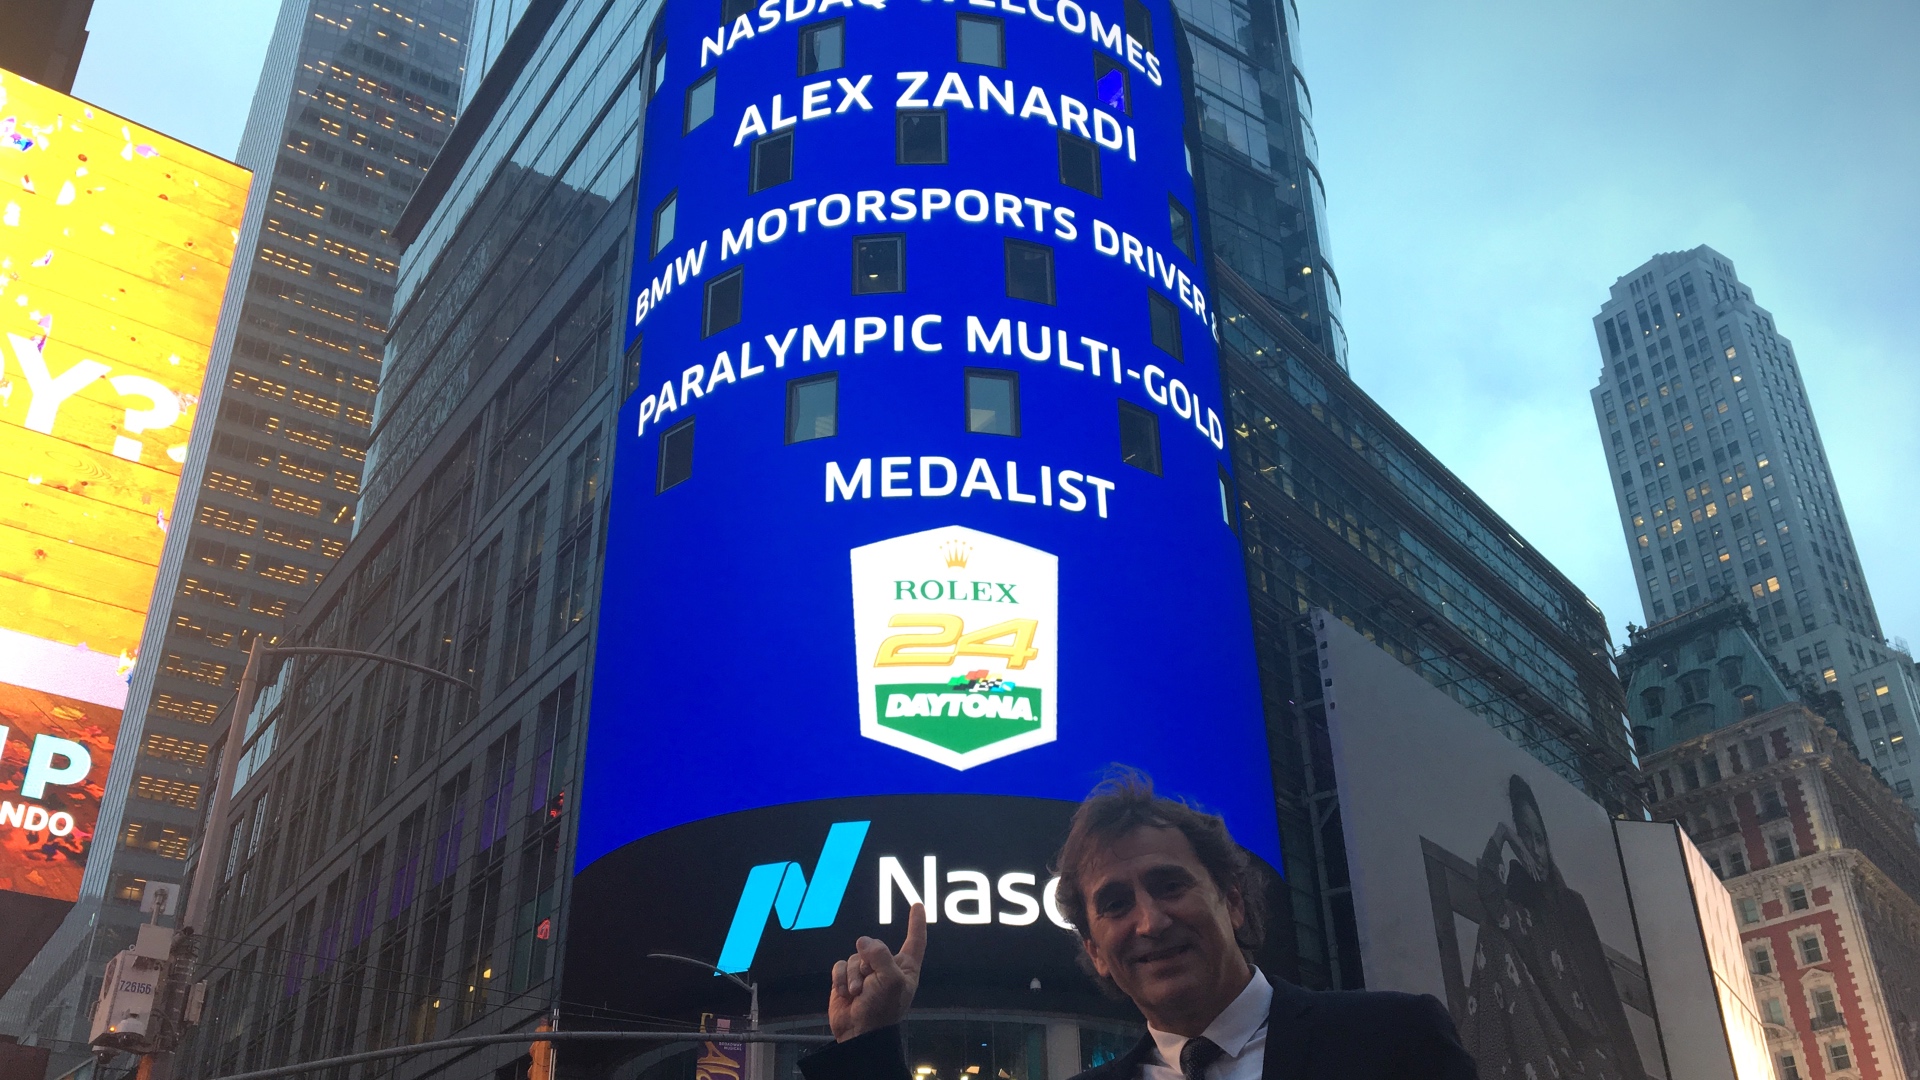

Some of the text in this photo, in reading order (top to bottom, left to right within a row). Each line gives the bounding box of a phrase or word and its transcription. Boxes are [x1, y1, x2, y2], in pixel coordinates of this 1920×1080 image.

[699, 0, 1163, 87] NASD COMES
[733, 72, 1137, 163] ALEX ZANARDI
[635, 240, 708, 327] BMW
[720, 187, 1078, 262] MOTORSPORTS
[1093, 219, 1208, 326] DRIVER
[0, 332, 181, 463] Y?
[637, 314, 1225, 451] PARALYMPIC MULTI-GOLD
[825, 456, 1116, 520] MEDALIST
[893, 579, 1020, 604] ROLEX
[873, 613, 1039, 670] 24
[884, 693, 1034, 721] DAYTONA
[878, 855, 1078, 930] Nas
[119, 980, 152, 995] 726156
